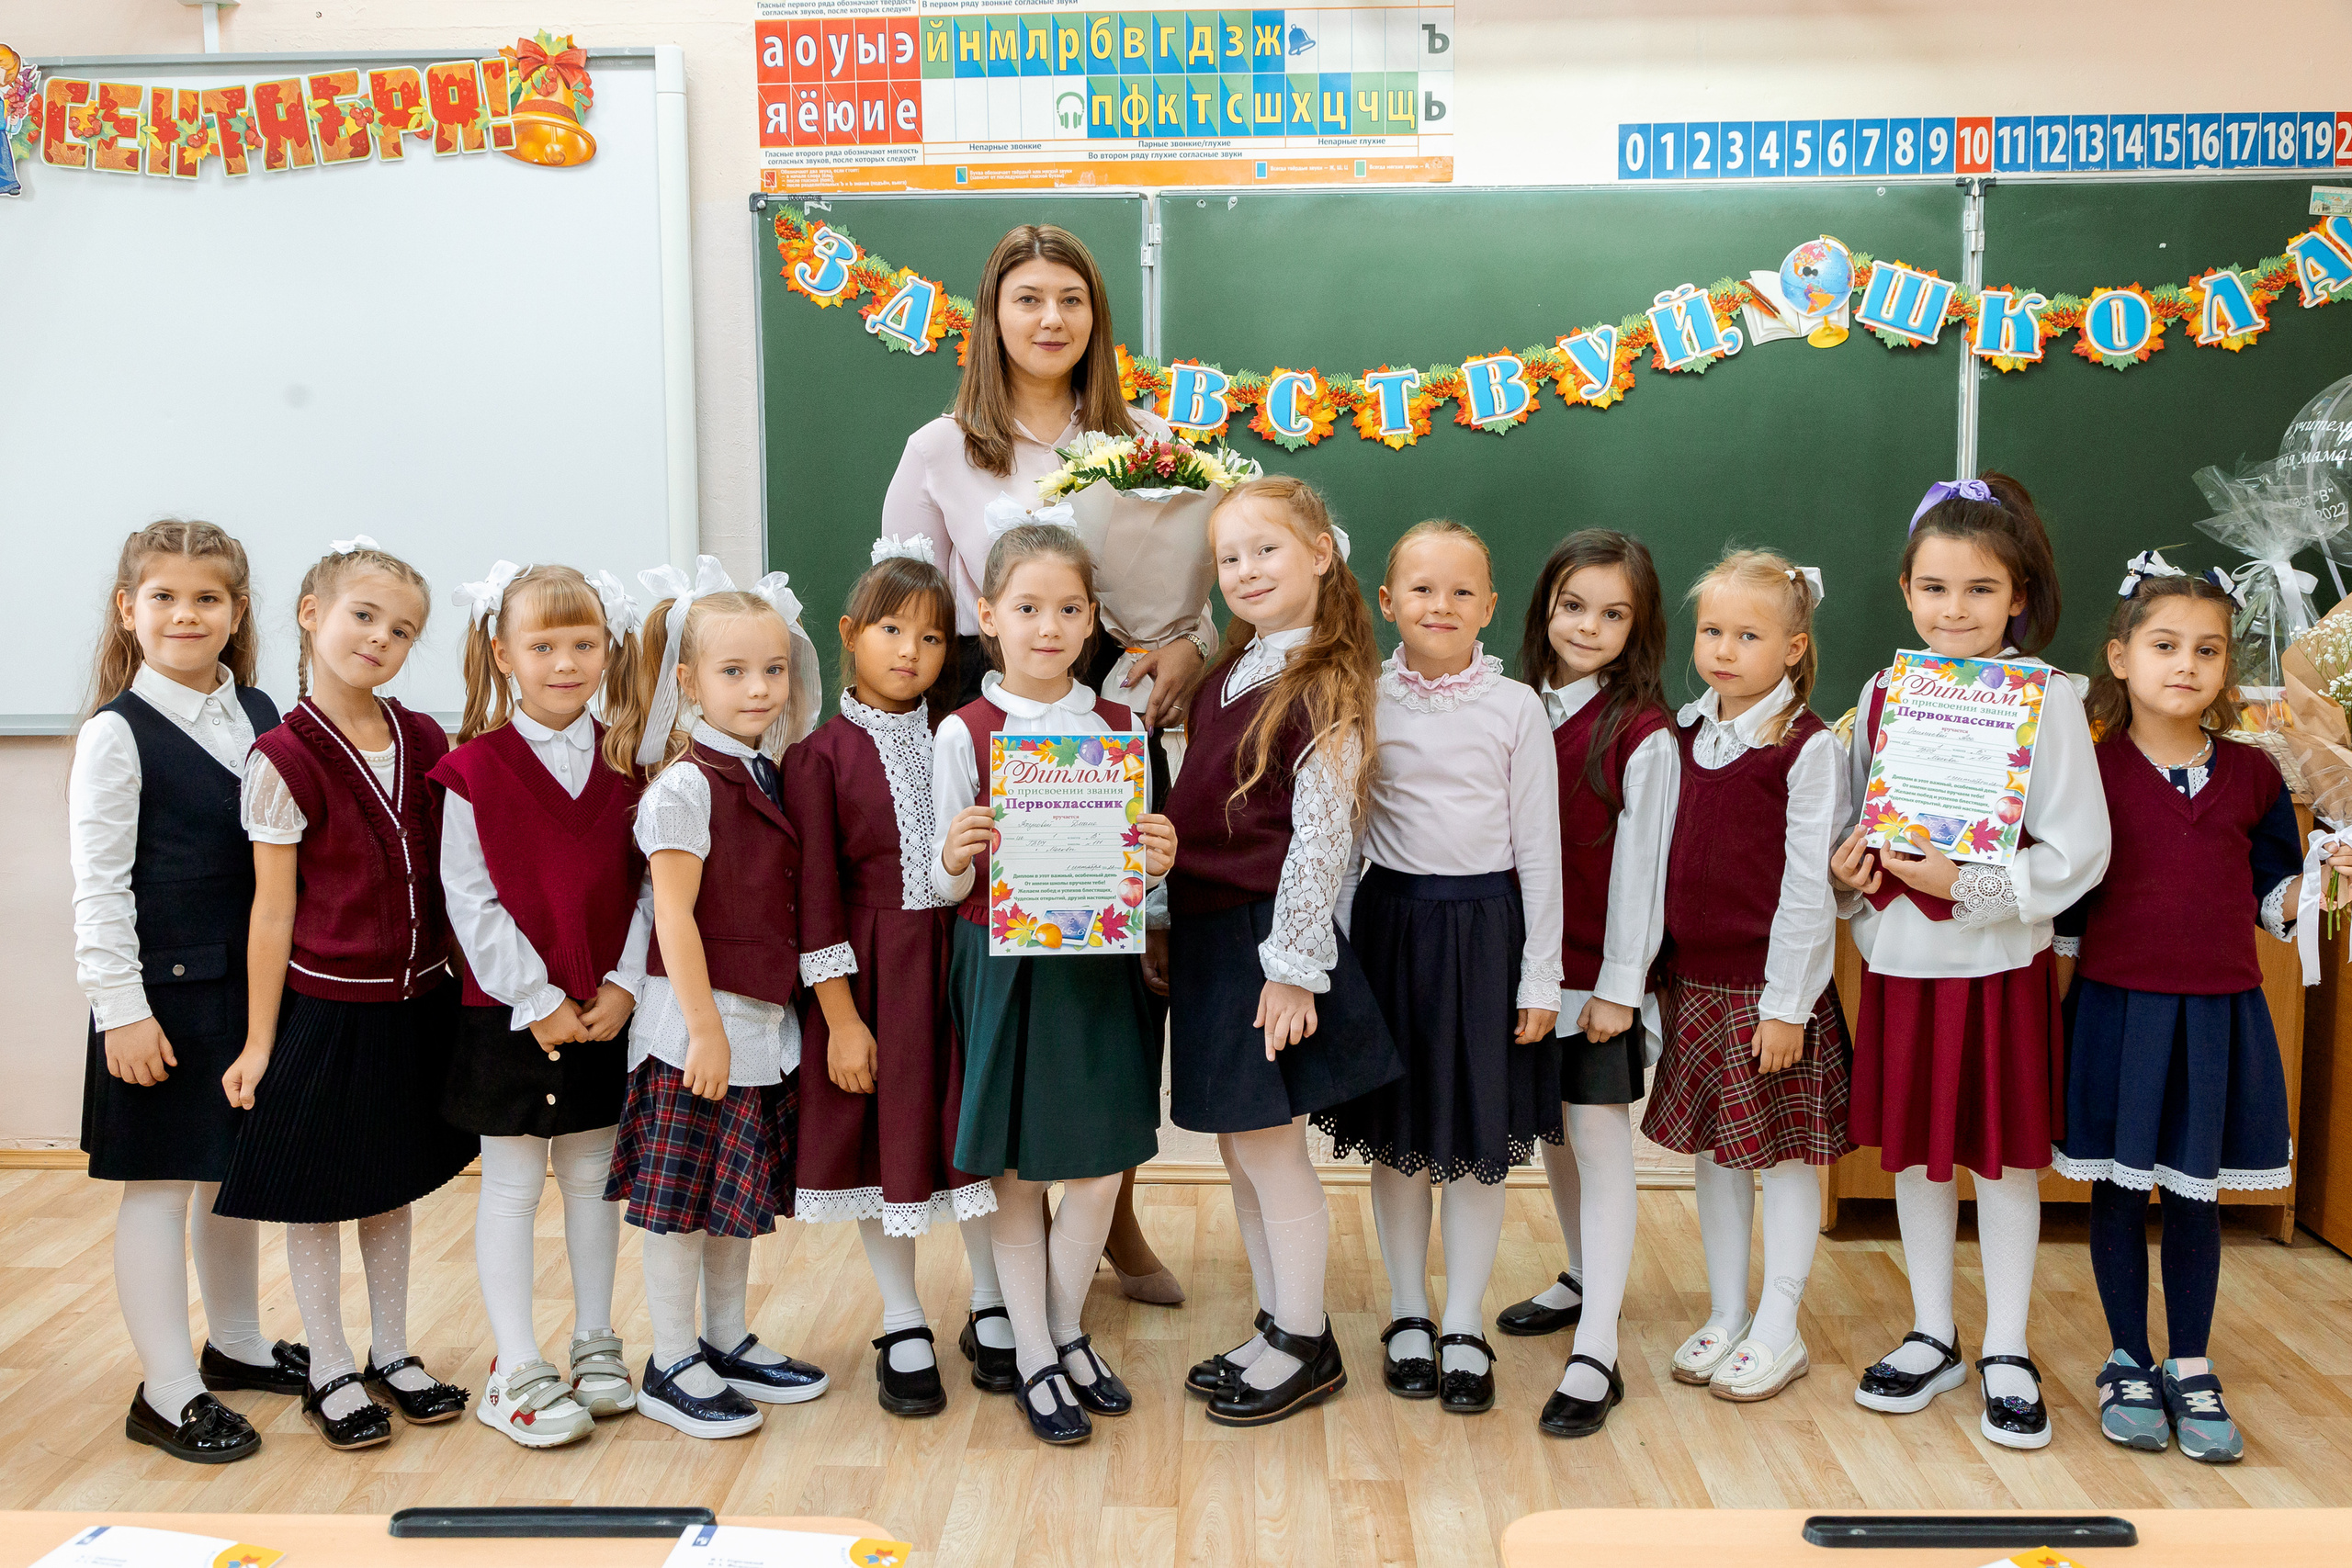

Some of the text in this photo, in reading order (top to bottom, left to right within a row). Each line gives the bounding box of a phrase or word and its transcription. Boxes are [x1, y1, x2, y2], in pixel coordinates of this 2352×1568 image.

[850, 6, 879, 15] которых
[41, 57, 516, 179] СЕНТЯБРЯ!
[969, 143, 1009, 152] Непарные
[1138, 140, 1231, 148] Парные звонкие/глухие
[1317, 137, 1386, 146] Непарные глухие
[1625, 120, 2352, 171] 0 1 2 3 4 5 6 7 8 9 10 11 12 13 14 15 16 17 18 19 2
[796, 150, 823, 158] второго
[1220, 151, 1243, 159] звуки
[1902, 674, 2018, 706] Диплом
[1911, 698, 1977, 713] присвоении
[1980, 707, 2018, 717] звания
[1896, 705, 2015, 729] Первоклассник
[1004, 760, 1120, 784] Диплом
[1017, 788, 1083, 797] присвоении
[1929, 780, 1953, 788] важный,
[1953, 784, 1984, 792] особенный
[1894, 788, 1916, 796] Желаем
[1959, 798, 1990, 807] блестящих,
[1005, 798, 1123, 813] Первоклассник
